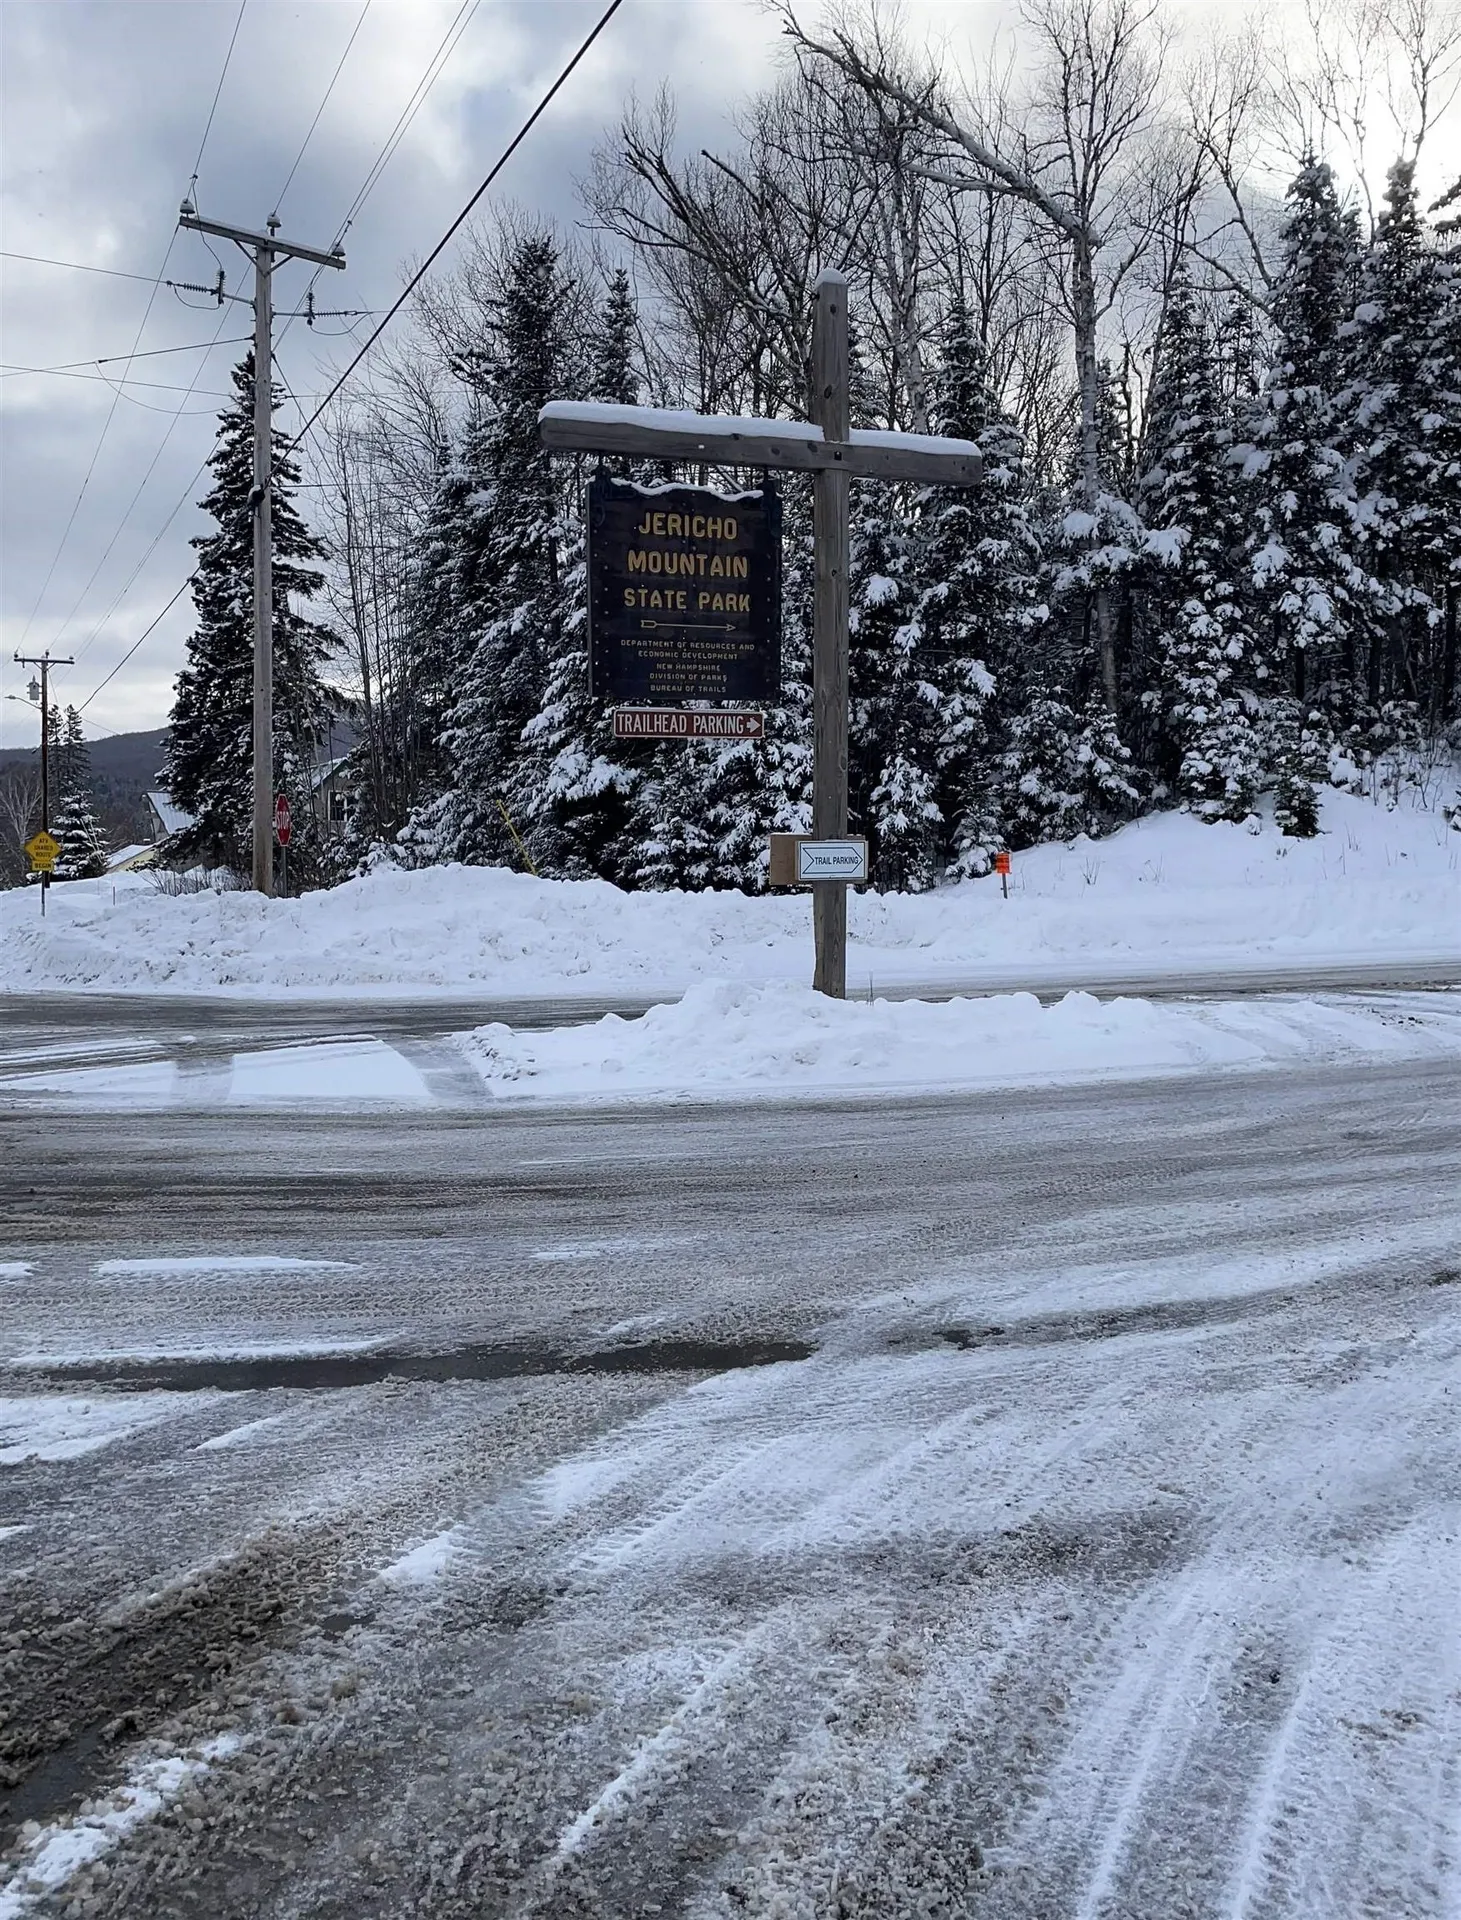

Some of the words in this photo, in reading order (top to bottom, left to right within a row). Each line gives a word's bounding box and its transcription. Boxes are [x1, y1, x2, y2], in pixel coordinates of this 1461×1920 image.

[638, 512, 738, 540] JERICHO
[627, 550, 749, 578] MOUNTAIN
[623, 588, 687, 610] STATE
[698, 592, 750, 612] PARK
[620, 639, 674, 648] DEPARTMENT
[677, 641, 687, 649] OF
[690, 642, 736, 650] RESOURCES
[739, 643, 755, 651] AND
[638, 650, 679, 658] ECONOMIC
[682, 652, 738, 660] DEVELOPMENT
[650, 684, 683, 692] BUREAU
[685, 685, 695, 693] OF
[698, 685, 726, 693] TRAILS
[617, 713, 687, 733] TRAILHEAD
[693, 715, 744, 734] PARKING
[276, 811, 290, 830] STOP
[814, 856, 832, 865] TRAIL
[832, 856, 859, 865] PARKING
